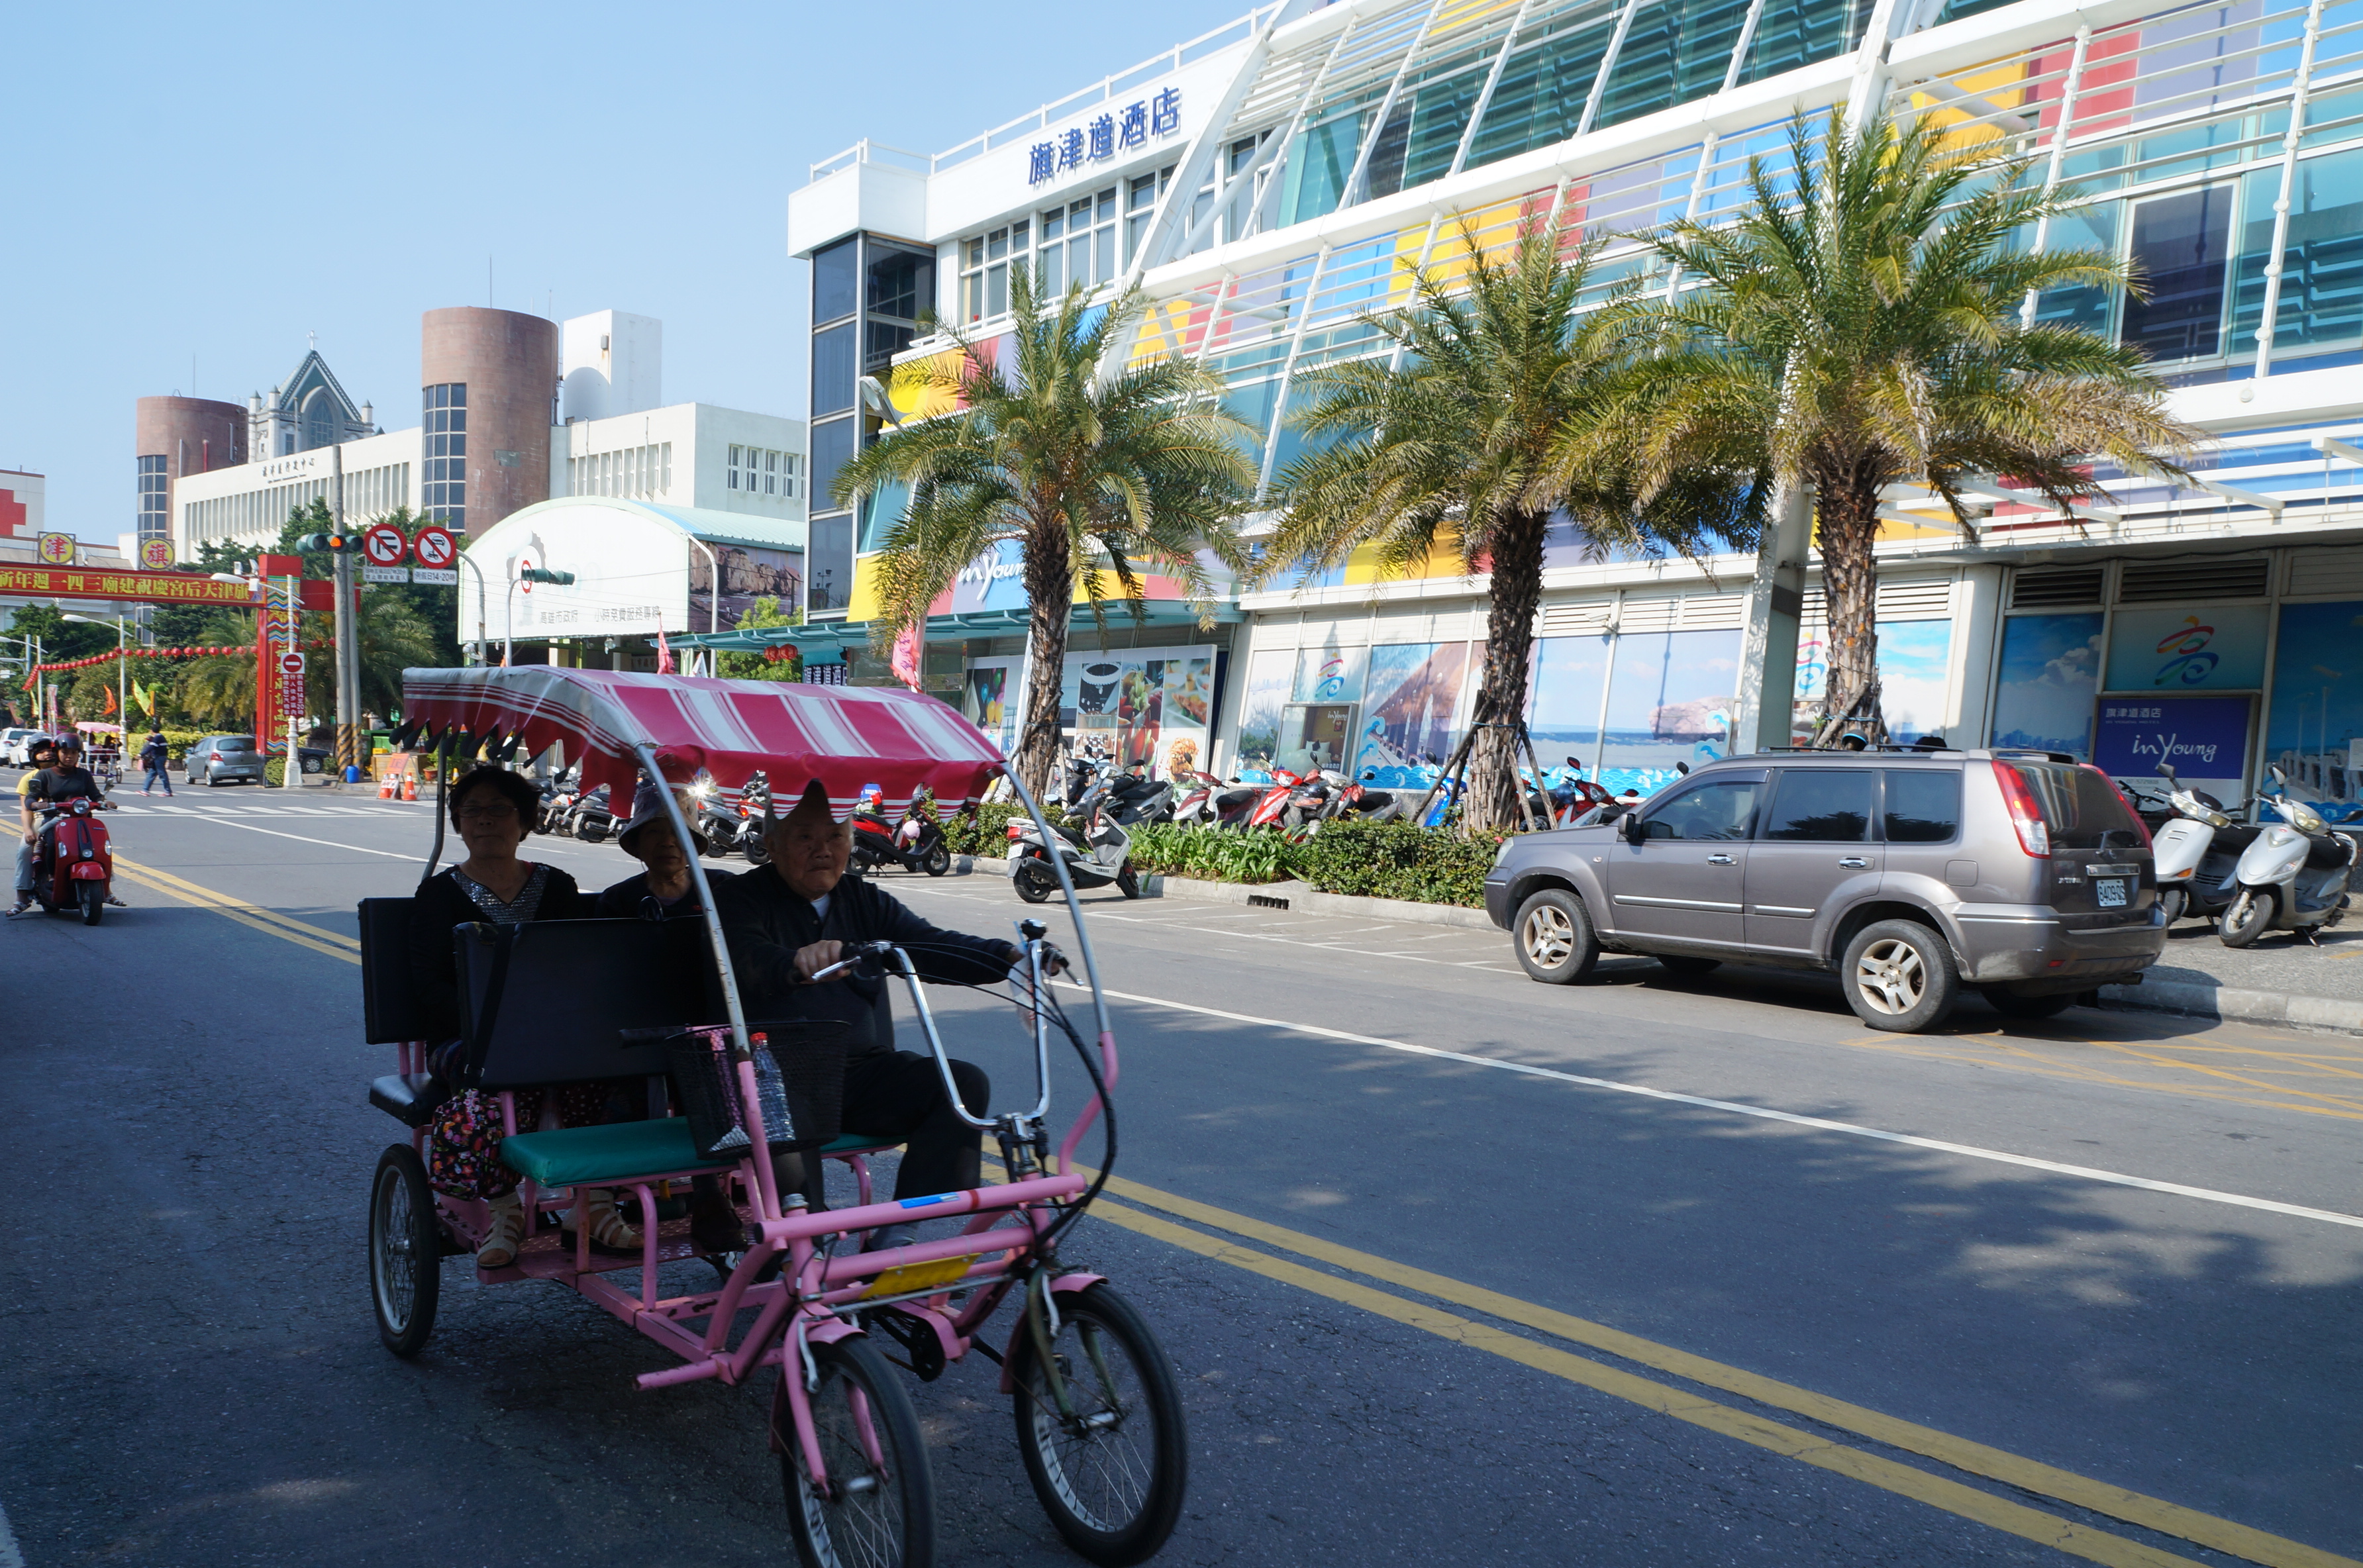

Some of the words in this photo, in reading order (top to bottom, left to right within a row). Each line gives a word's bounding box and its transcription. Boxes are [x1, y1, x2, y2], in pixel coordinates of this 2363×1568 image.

[1029, 87, 1180, 185] 旗津道酒店
[46, 536, 68, 561] 津
[146, 543, 168, 565] 旗
[958, 552, 1027, 601] inYoun
[2105, 708, 2162, 718] 旗津道酒店
